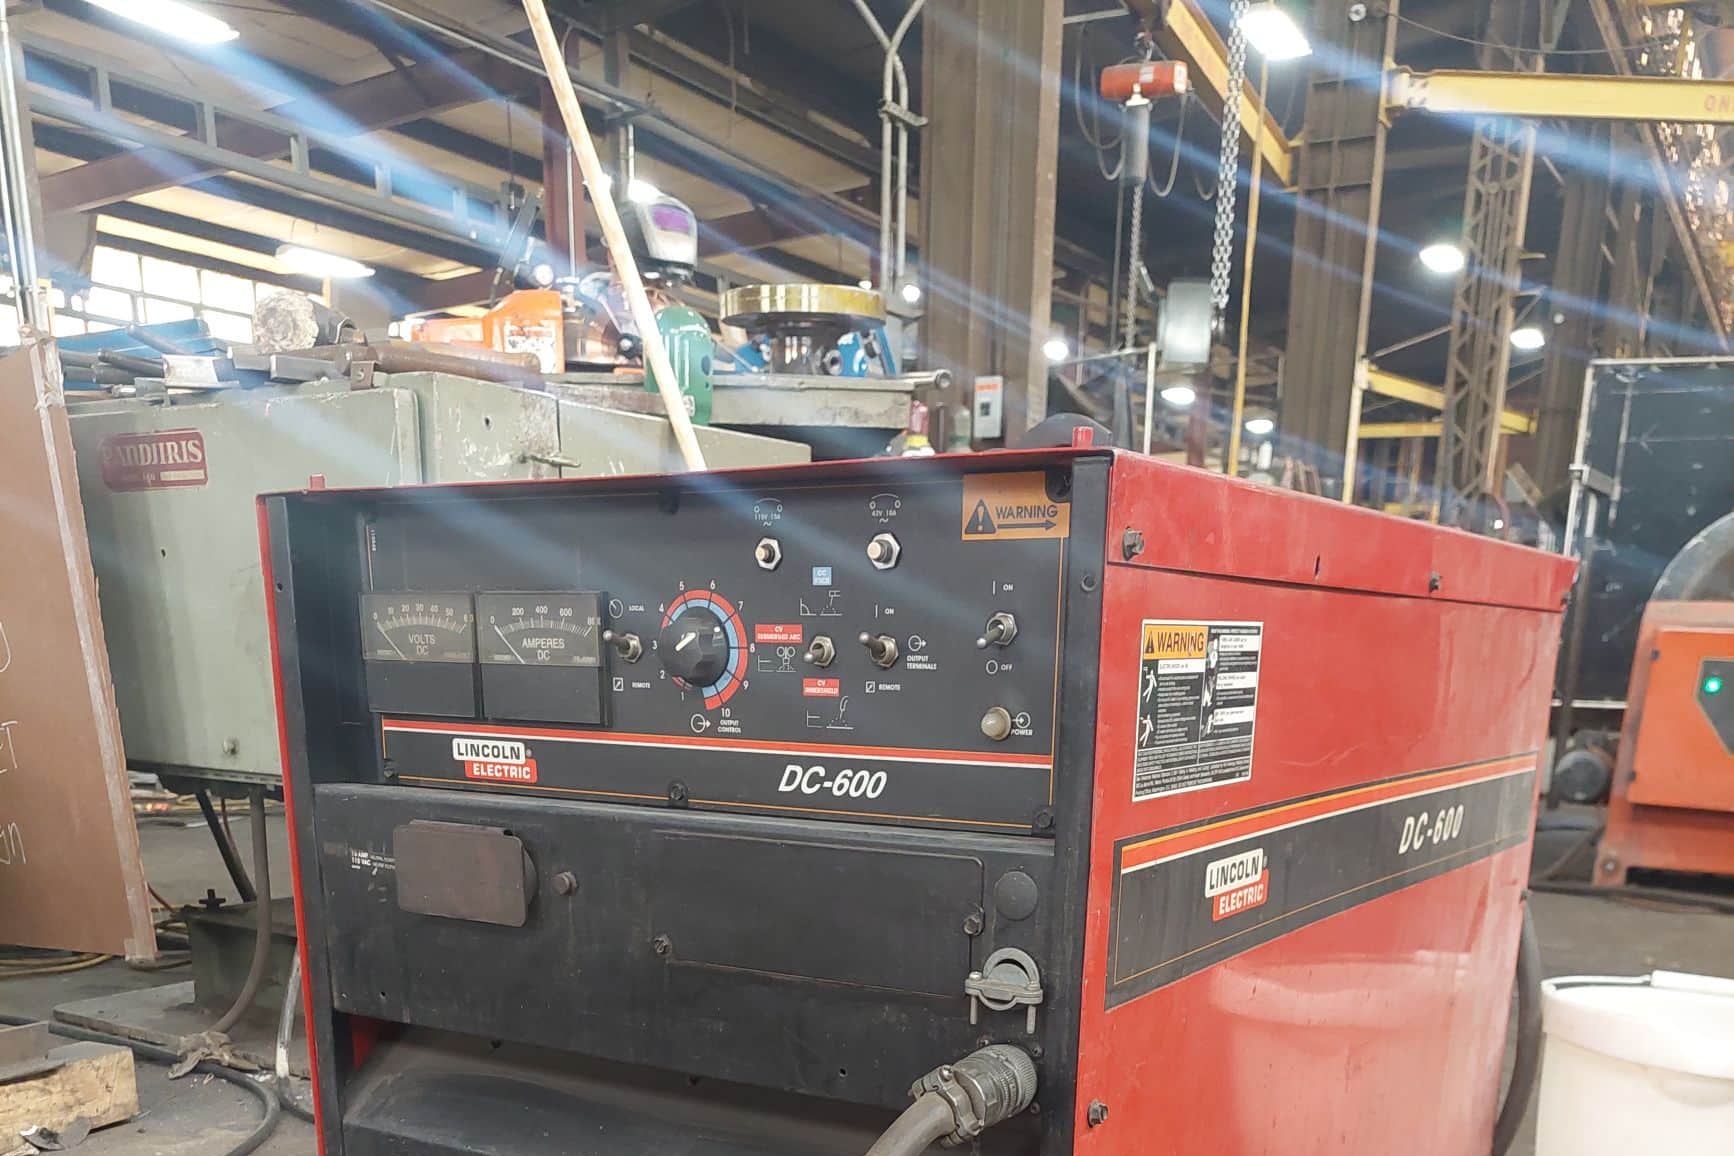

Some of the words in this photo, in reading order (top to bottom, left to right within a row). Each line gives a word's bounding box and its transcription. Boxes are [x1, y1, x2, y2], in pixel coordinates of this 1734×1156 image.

[995, 504, 1058, 520] WARNING
[679, 581, 685, 591] 5
[710, 579, 716, 590] 6
[1003, 583, 1013, 591] ON
[401, 604, 410, 612] 20
[415, 603, 425, 611] 30
[535, 606, 548, 614] 400
[658, 603, 665, 613] 4
[738, 601, 744, 611] 7
[512, 608, 524, 616] 200
[560, 608, 572, 616] 600
[490, 616, 495, 624] 0
[408, 634, 435, 645] VOLTS
[521, 638, 565, 649] AMPERES
[1157, 631, 1204, 655] WARNING
[652, 640, 658, 650] 3
[750, 643, 755, 653] 8
[416, 645, 429, 656] DC
[537, 650, 550, 661] DC
[906, 662, 937, 671] TERMINALS
[1001, 663, 1013, 671] OFF
[659, 670, 665, 679] 2
[743, 680, 749, 690] 9
[817, 679, 826, 687] CV
[878, 684, 901, 692] REMOTE
[681, 693, 685, 701] 1
[721, 708, 731, 718] 10
[720, 719, 739, 727] OUTPUT
[717, 726, 741, 734] CONTROL
[1011, 729, 1033, 737] POWER
[456, 743, 520, 760] LINCOLN
[472, 763, 531, 779] ELECTRIC
[778, 764, 888, 799] DC-600
[1399, 805, 1464, 854] DC-600
[1209, 855, 1260, 890] LINCOLN
[1218, 884, 1264, 915] ELECTRIC
